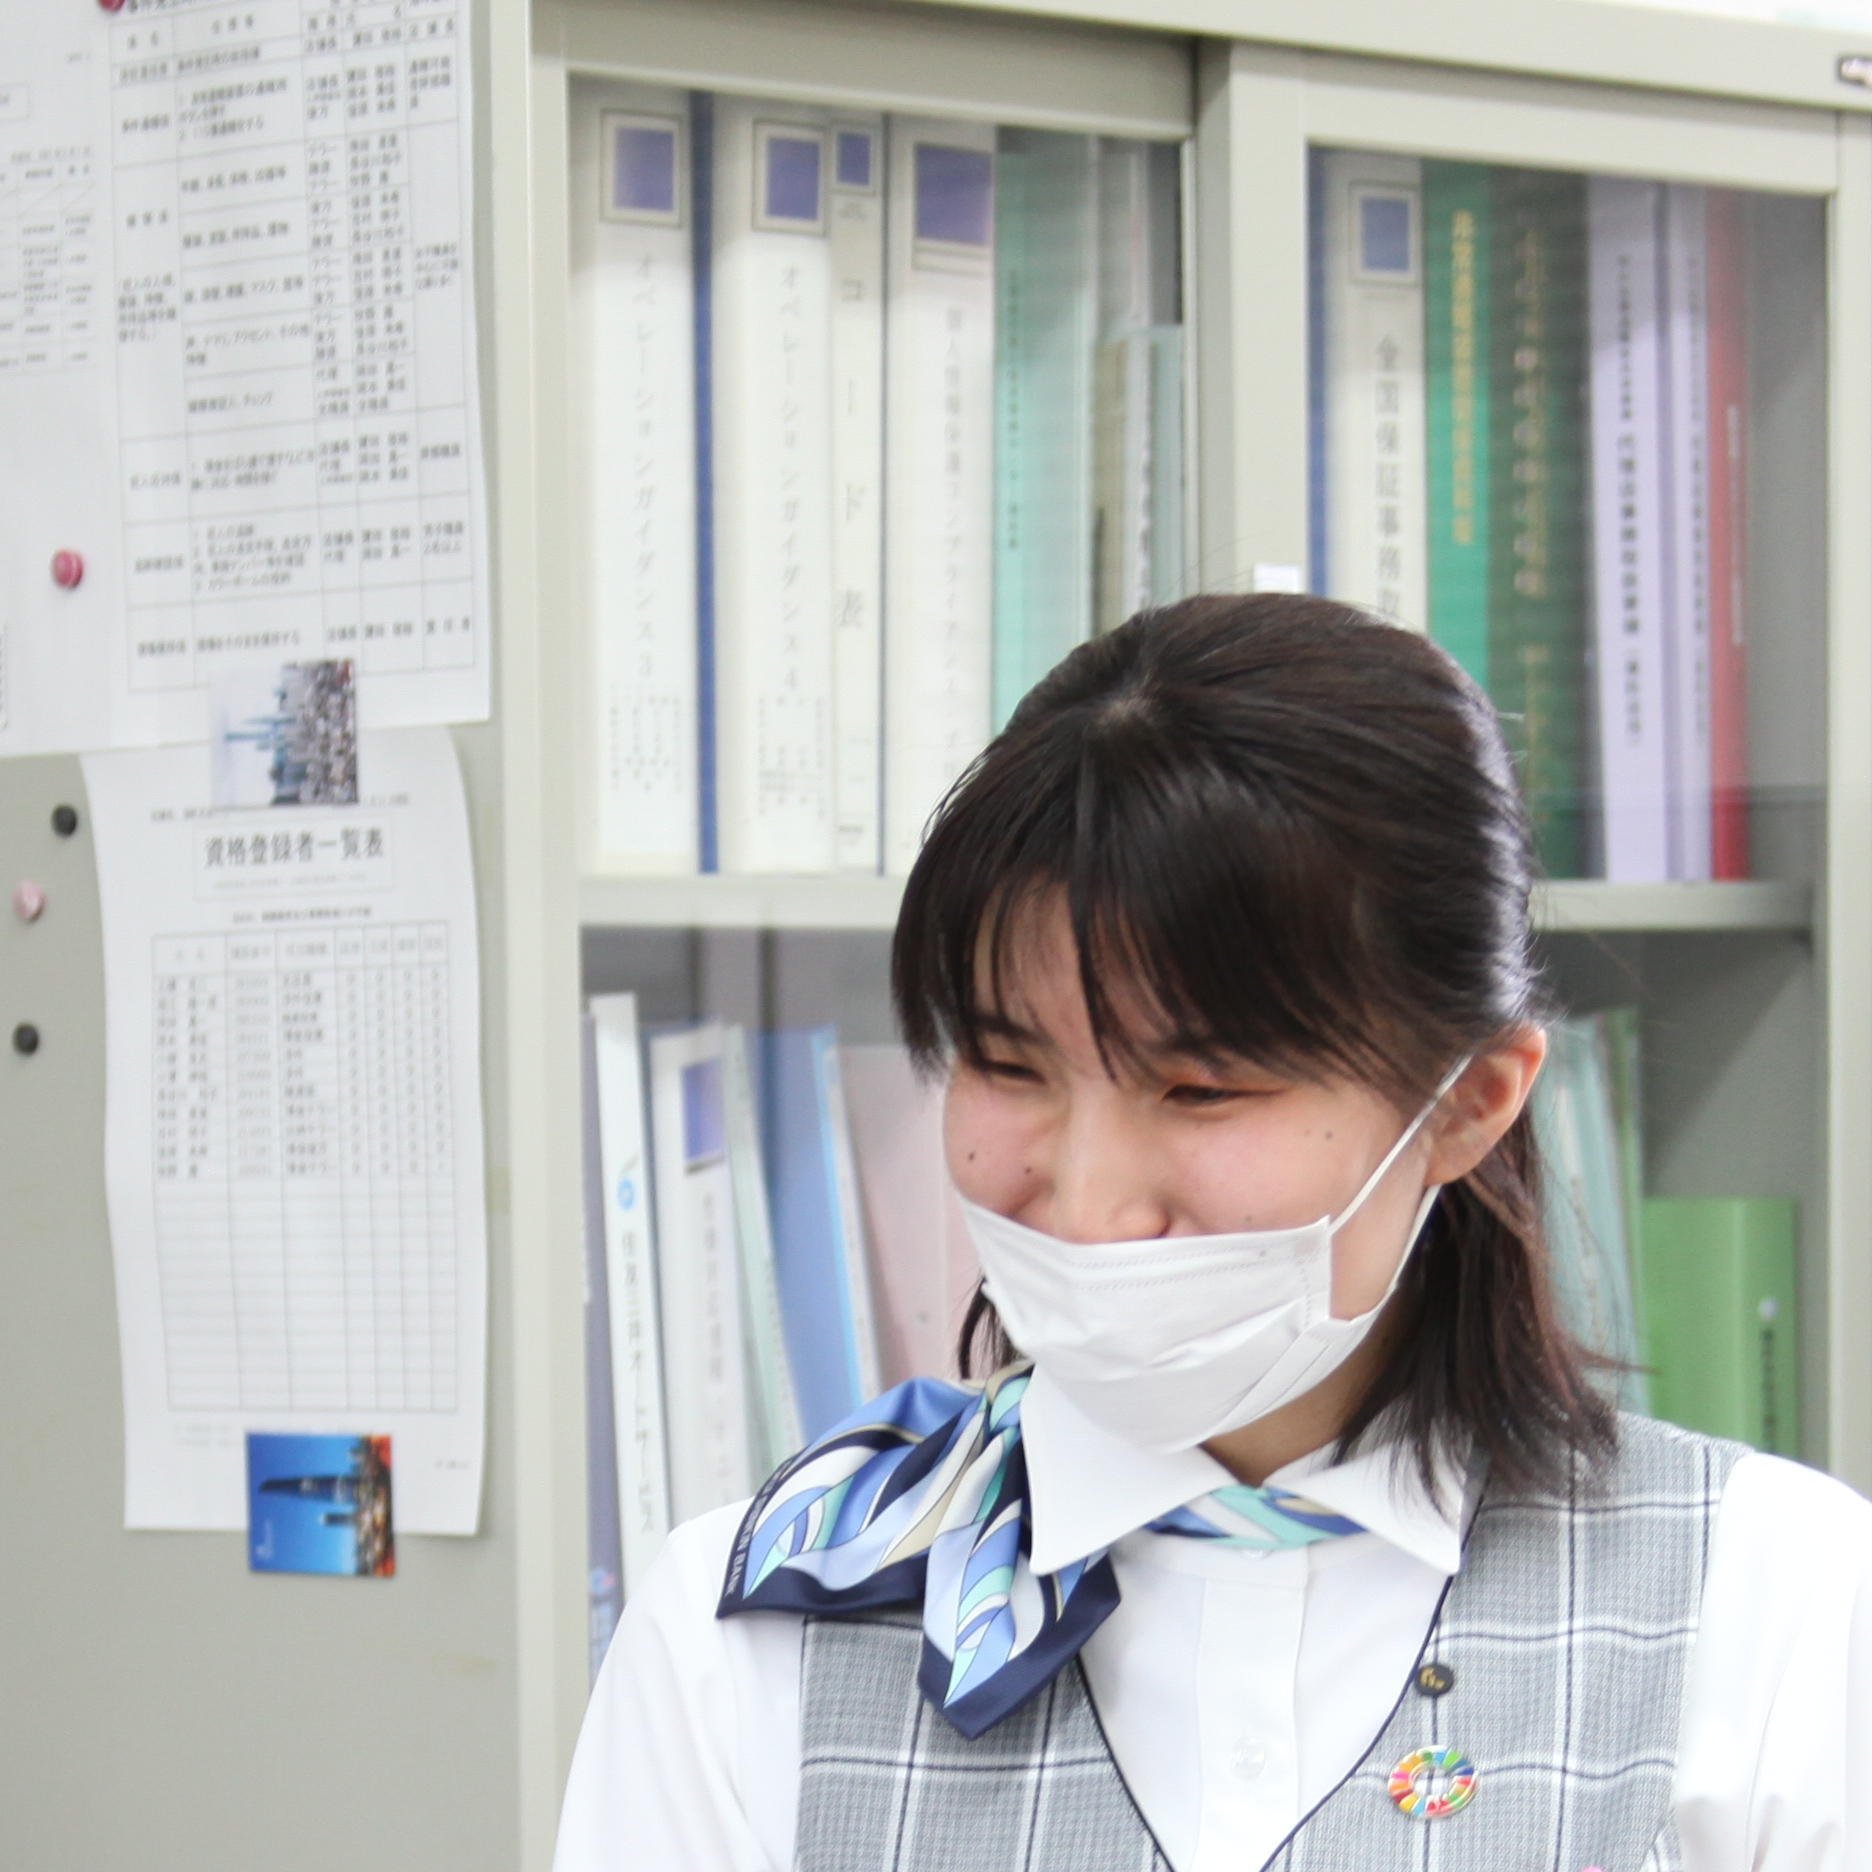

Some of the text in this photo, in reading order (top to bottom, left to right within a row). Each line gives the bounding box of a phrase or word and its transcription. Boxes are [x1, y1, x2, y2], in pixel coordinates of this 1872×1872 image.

[204, 827, 385, 869] 資格登録者一覧表
